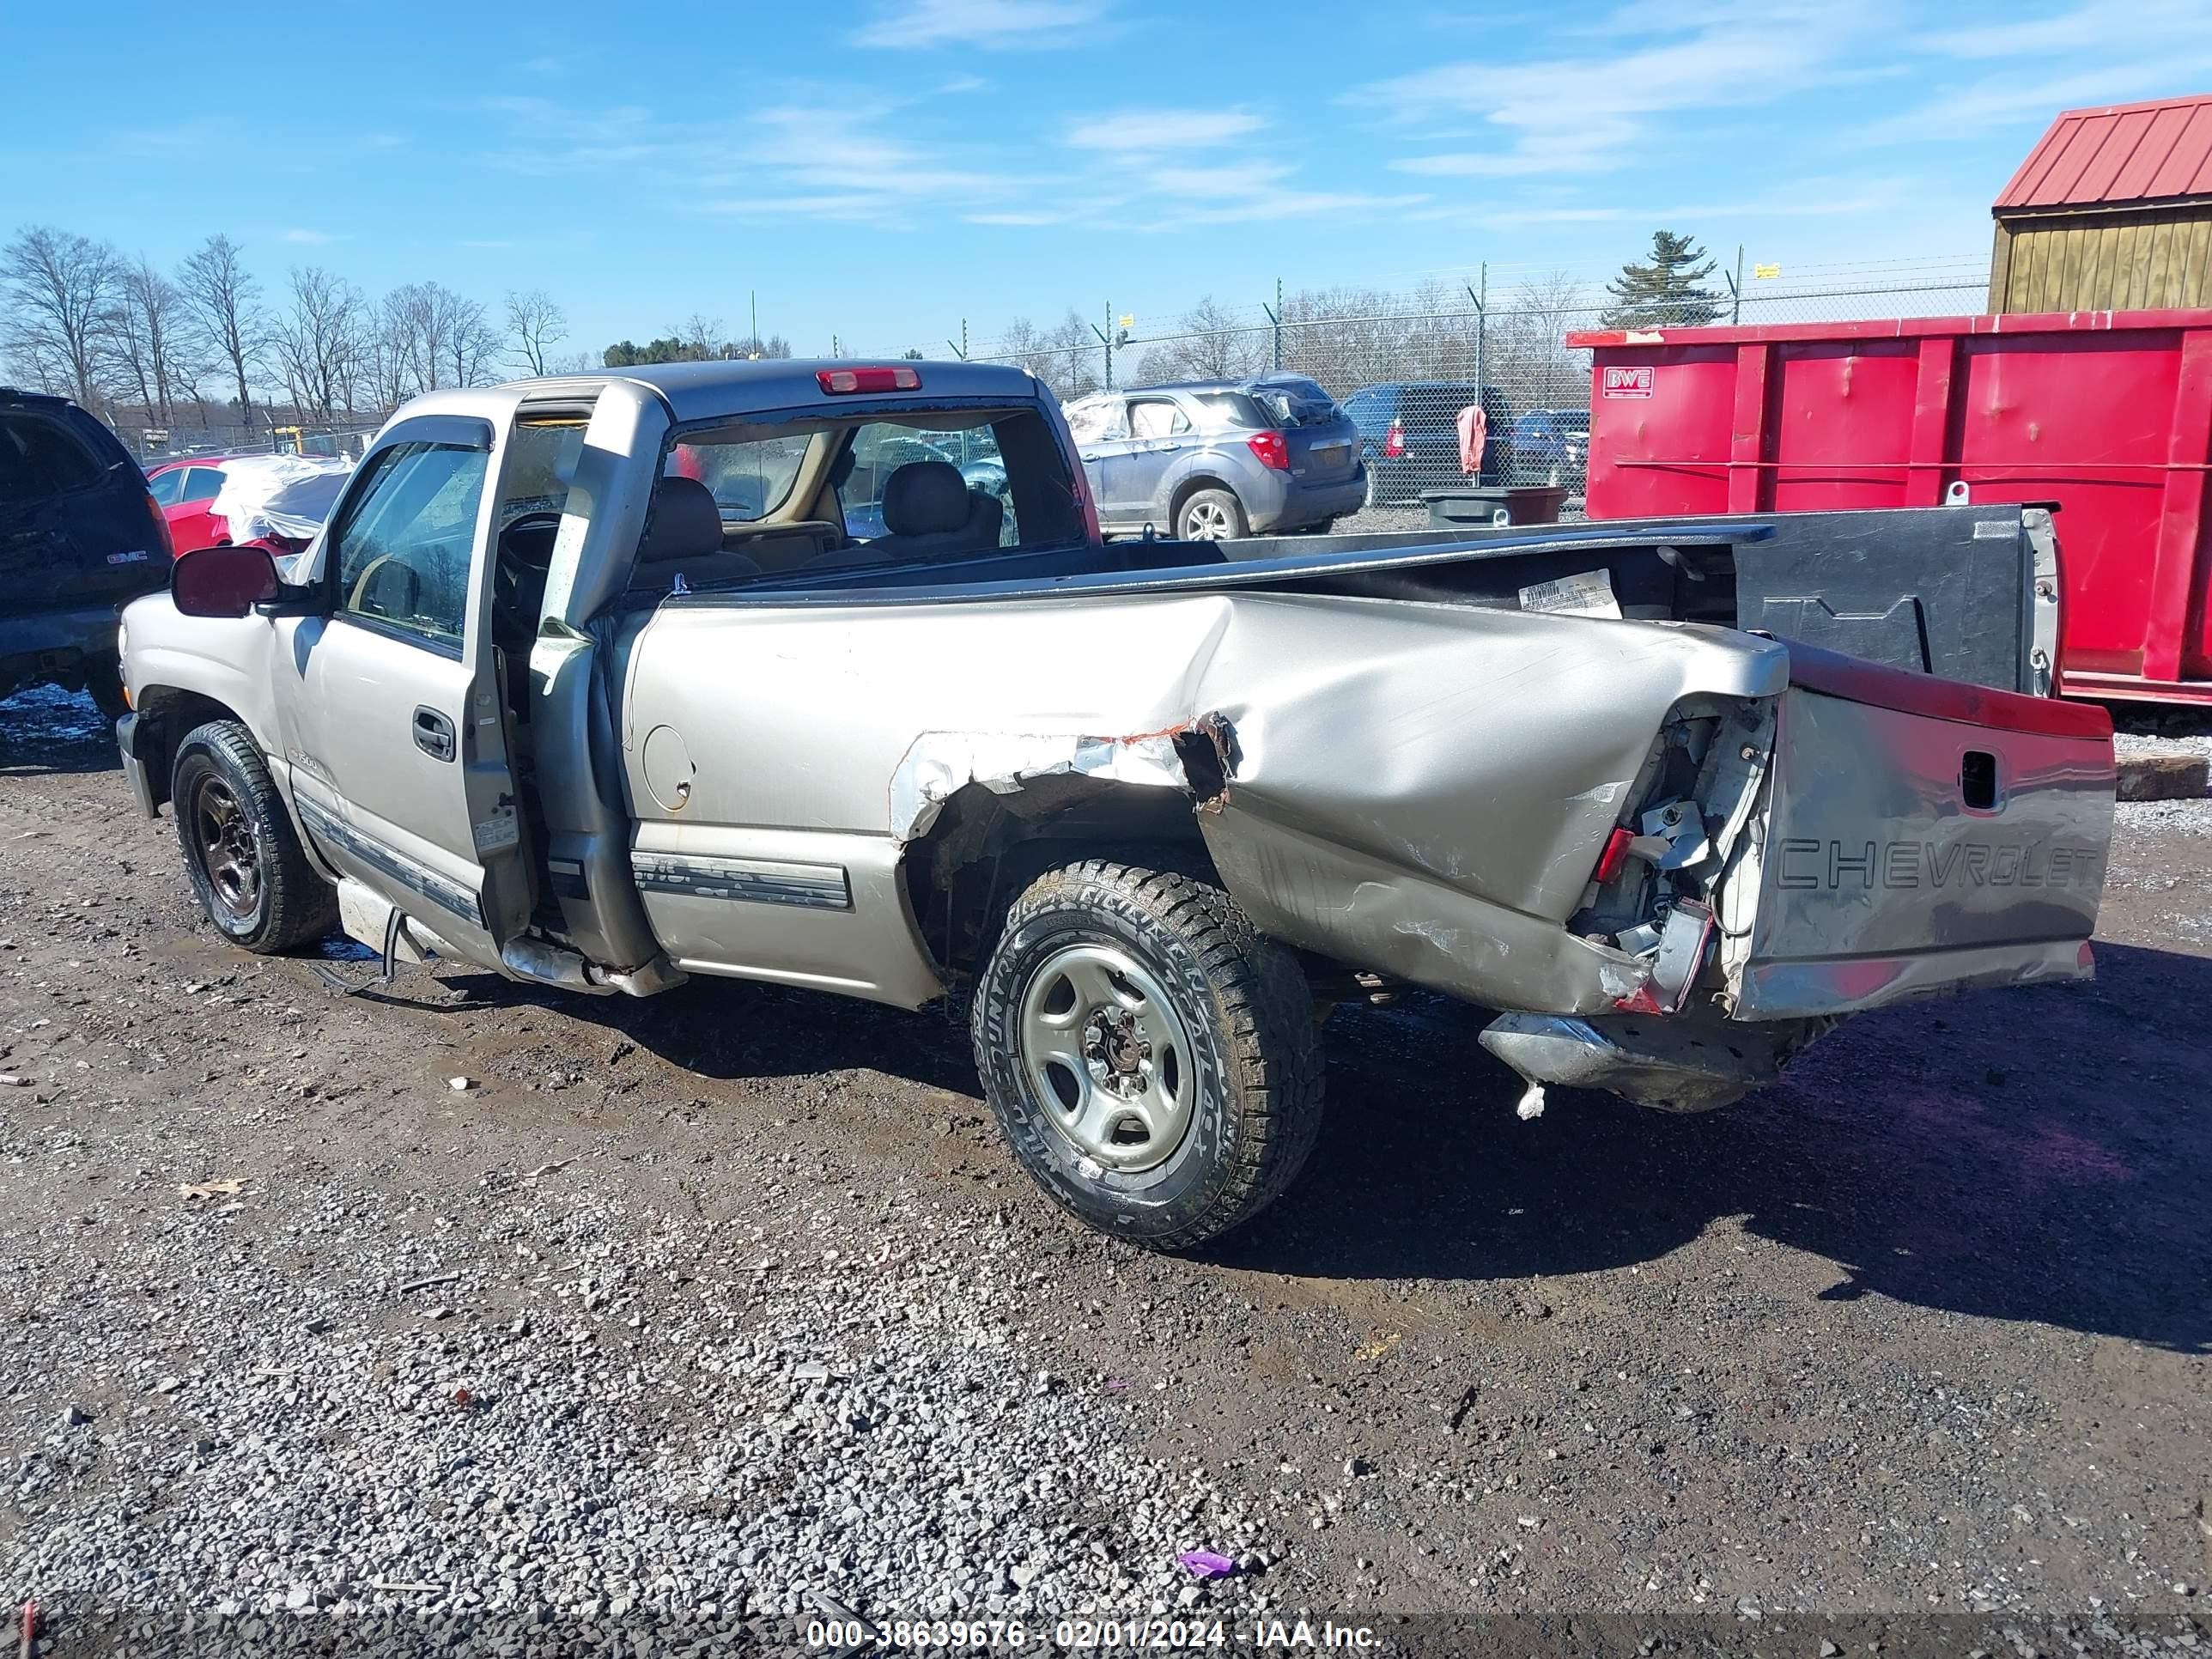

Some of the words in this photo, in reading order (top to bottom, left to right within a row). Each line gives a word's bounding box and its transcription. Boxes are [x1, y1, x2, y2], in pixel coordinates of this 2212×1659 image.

[1607, 369, 1650, 387] BWE
[106, 550, 148, 564] GMC
[298, 752, 317, 769] 1500
[1777, 837, 2098, 890] CHEVROLET
